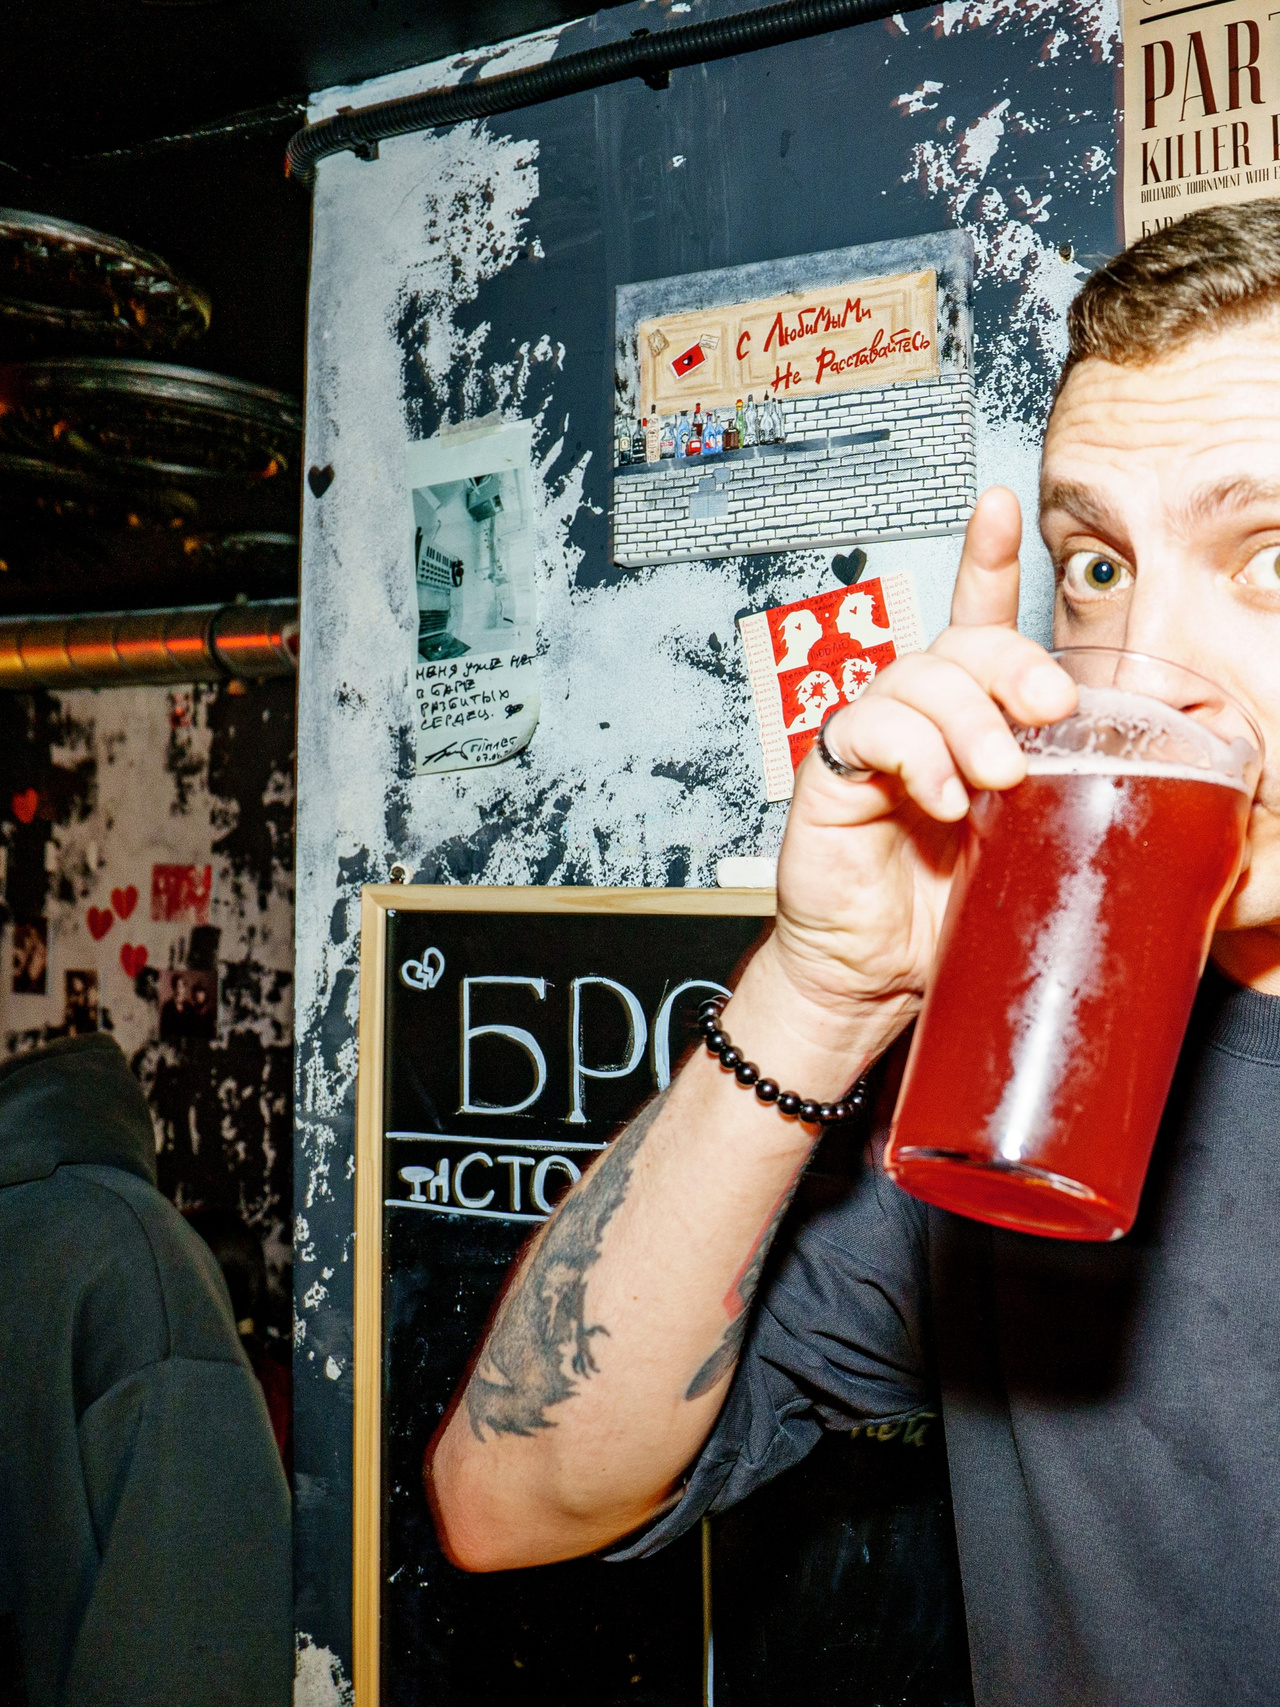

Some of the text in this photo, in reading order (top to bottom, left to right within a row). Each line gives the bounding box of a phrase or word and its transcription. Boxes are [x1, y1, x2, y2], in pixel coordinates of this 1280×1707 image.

[1141, 121, 1252, 186] KILLER
[1141, 184, 1181, 203] BILLIARDS
[1186, 173, 1242, 195] TOURNAMENT
[1245, 168, 1269, 185] WITH
